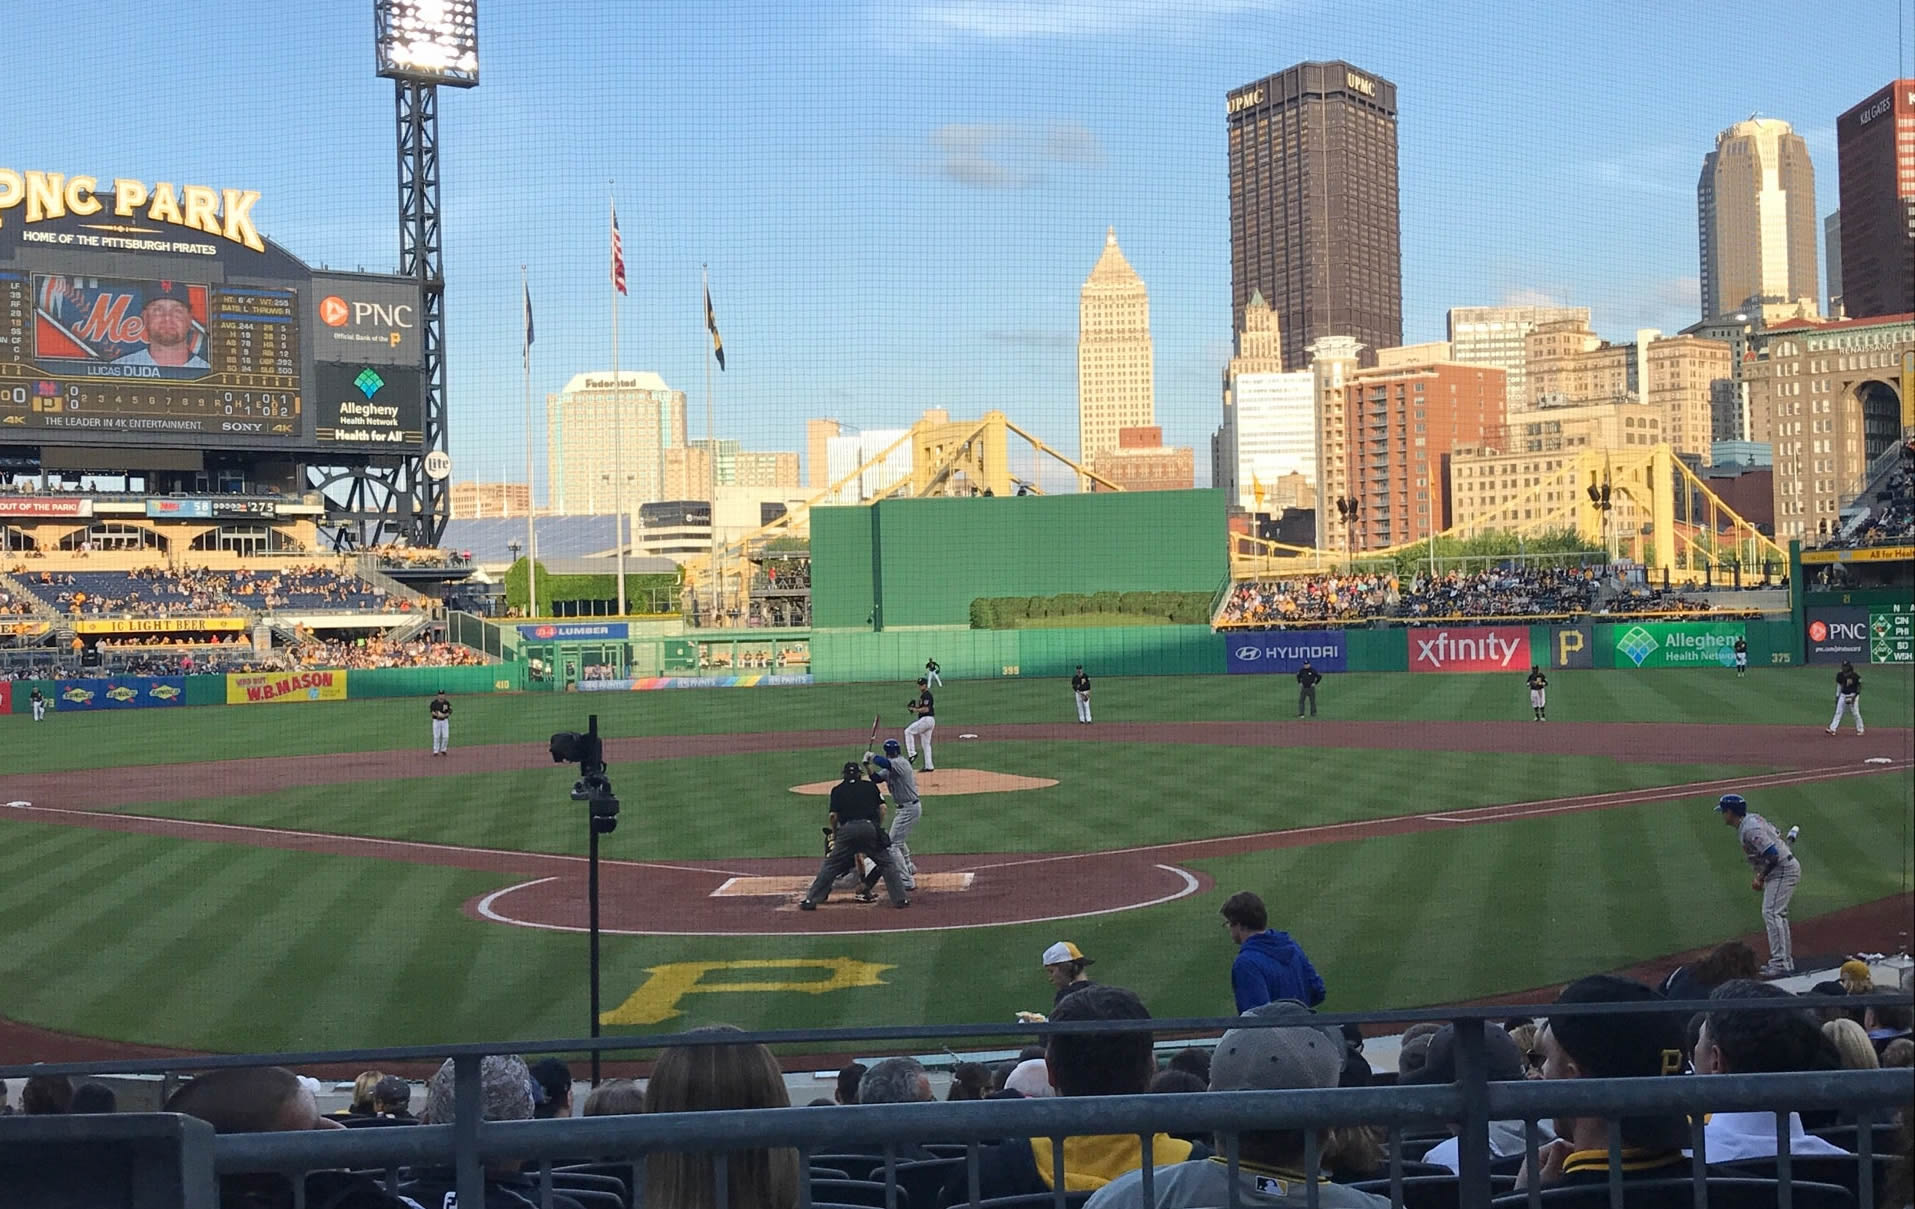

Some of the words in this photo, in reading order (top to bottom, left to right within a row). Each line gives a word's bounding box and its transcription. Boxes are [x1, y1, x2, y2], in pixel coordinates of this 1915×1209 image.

[1347, 73, 1376, 97] UPMC
[1226, 88, 1264, 114] UPMC
[0, 168, 103, 228] PNC
[114, 178, 265, 254] PARK
[23, 230, 57, 244] HOME
[58, 233, 75, 244] OF
[76, 234, 99, 246] THE
[101, 236, 171, 253] PITTSBURGH
[172, 242, 217, 255] PIRATES
[352, 301, 414, 328] PNC
[333, 332, 354, 341] Official
[355, 333, 371, 342] Bank
[371, 333, 379, 342] of
[379, 334, 389, 342] the
[1840, 342, 1895, 355] RENAISSANCE
[87, 365, 121, 377] LUCAS
[123, 365, 161, 378] DUDA
[70, 386, 79, 397] 0
[224, 392, 233, 402] 0
[244, 393, 251, 403] 1
[262, 393, 270, 403] 0
[280, 395, 287, 404] 1
[70, 400, 79, 410] 0
[224, 405, 233, 415] 0
[244, 406, 251, 415] 1
[262, 406, 270, 416] 0
[280, 407, 288, 417] 2
[340, 402, 399, 418] Allegheny
[3, 416, 26, 425] 4K
[45, 416, 63, 426] THE
[65, 417, 101, 427] LEADER
[103, 419, 113, 427] IN
[115, 419, 127, 428] 4K
[340, 416, 366, 426] Health
[366, 417, 399, 426] Network
[222, 421, 263, 432] SONY
[272, 424, 293, 433] 4K
[335, 429, 370, 441] Health
[371, 430, 386, 442] for
[387, 431, 403, 442] All
[428, 458, 449, 472] Lite
[0, 502, 18, 511] OUT
[19, 503, 32, 511] OF
[33, 503, 50, 511] THE
[52, 503, 77, 511] PARK!
[193, 501, 209, 511] 58
[1870, 550, 1880, 559] All
[1882, 549, 1893, 558] for
[112, 621, 124, 631] IC
[129, 620, 172, 631] LIGHT
[176, 619, 206, 630] BEER
[1894, 616, 1909, 625] CIN
[558, 626, 609, 636] LUMBER
[1829, 623, 1867, 640] PNC
[1895, 627, 1909, 636] PHI
[1266, 645, 1338, 659] HYUNDAI
[1417, 632, 1520, 667] xfinity
[1559, 629, 1584, 666] P
[1666, 650, 1699, 661] Health
[1771, 653, 1791, 663] 375
[495, 679, 510, 689] 410
[599, 957, 898, 1025] P
[1662, 1048, 1683, 1076] P
